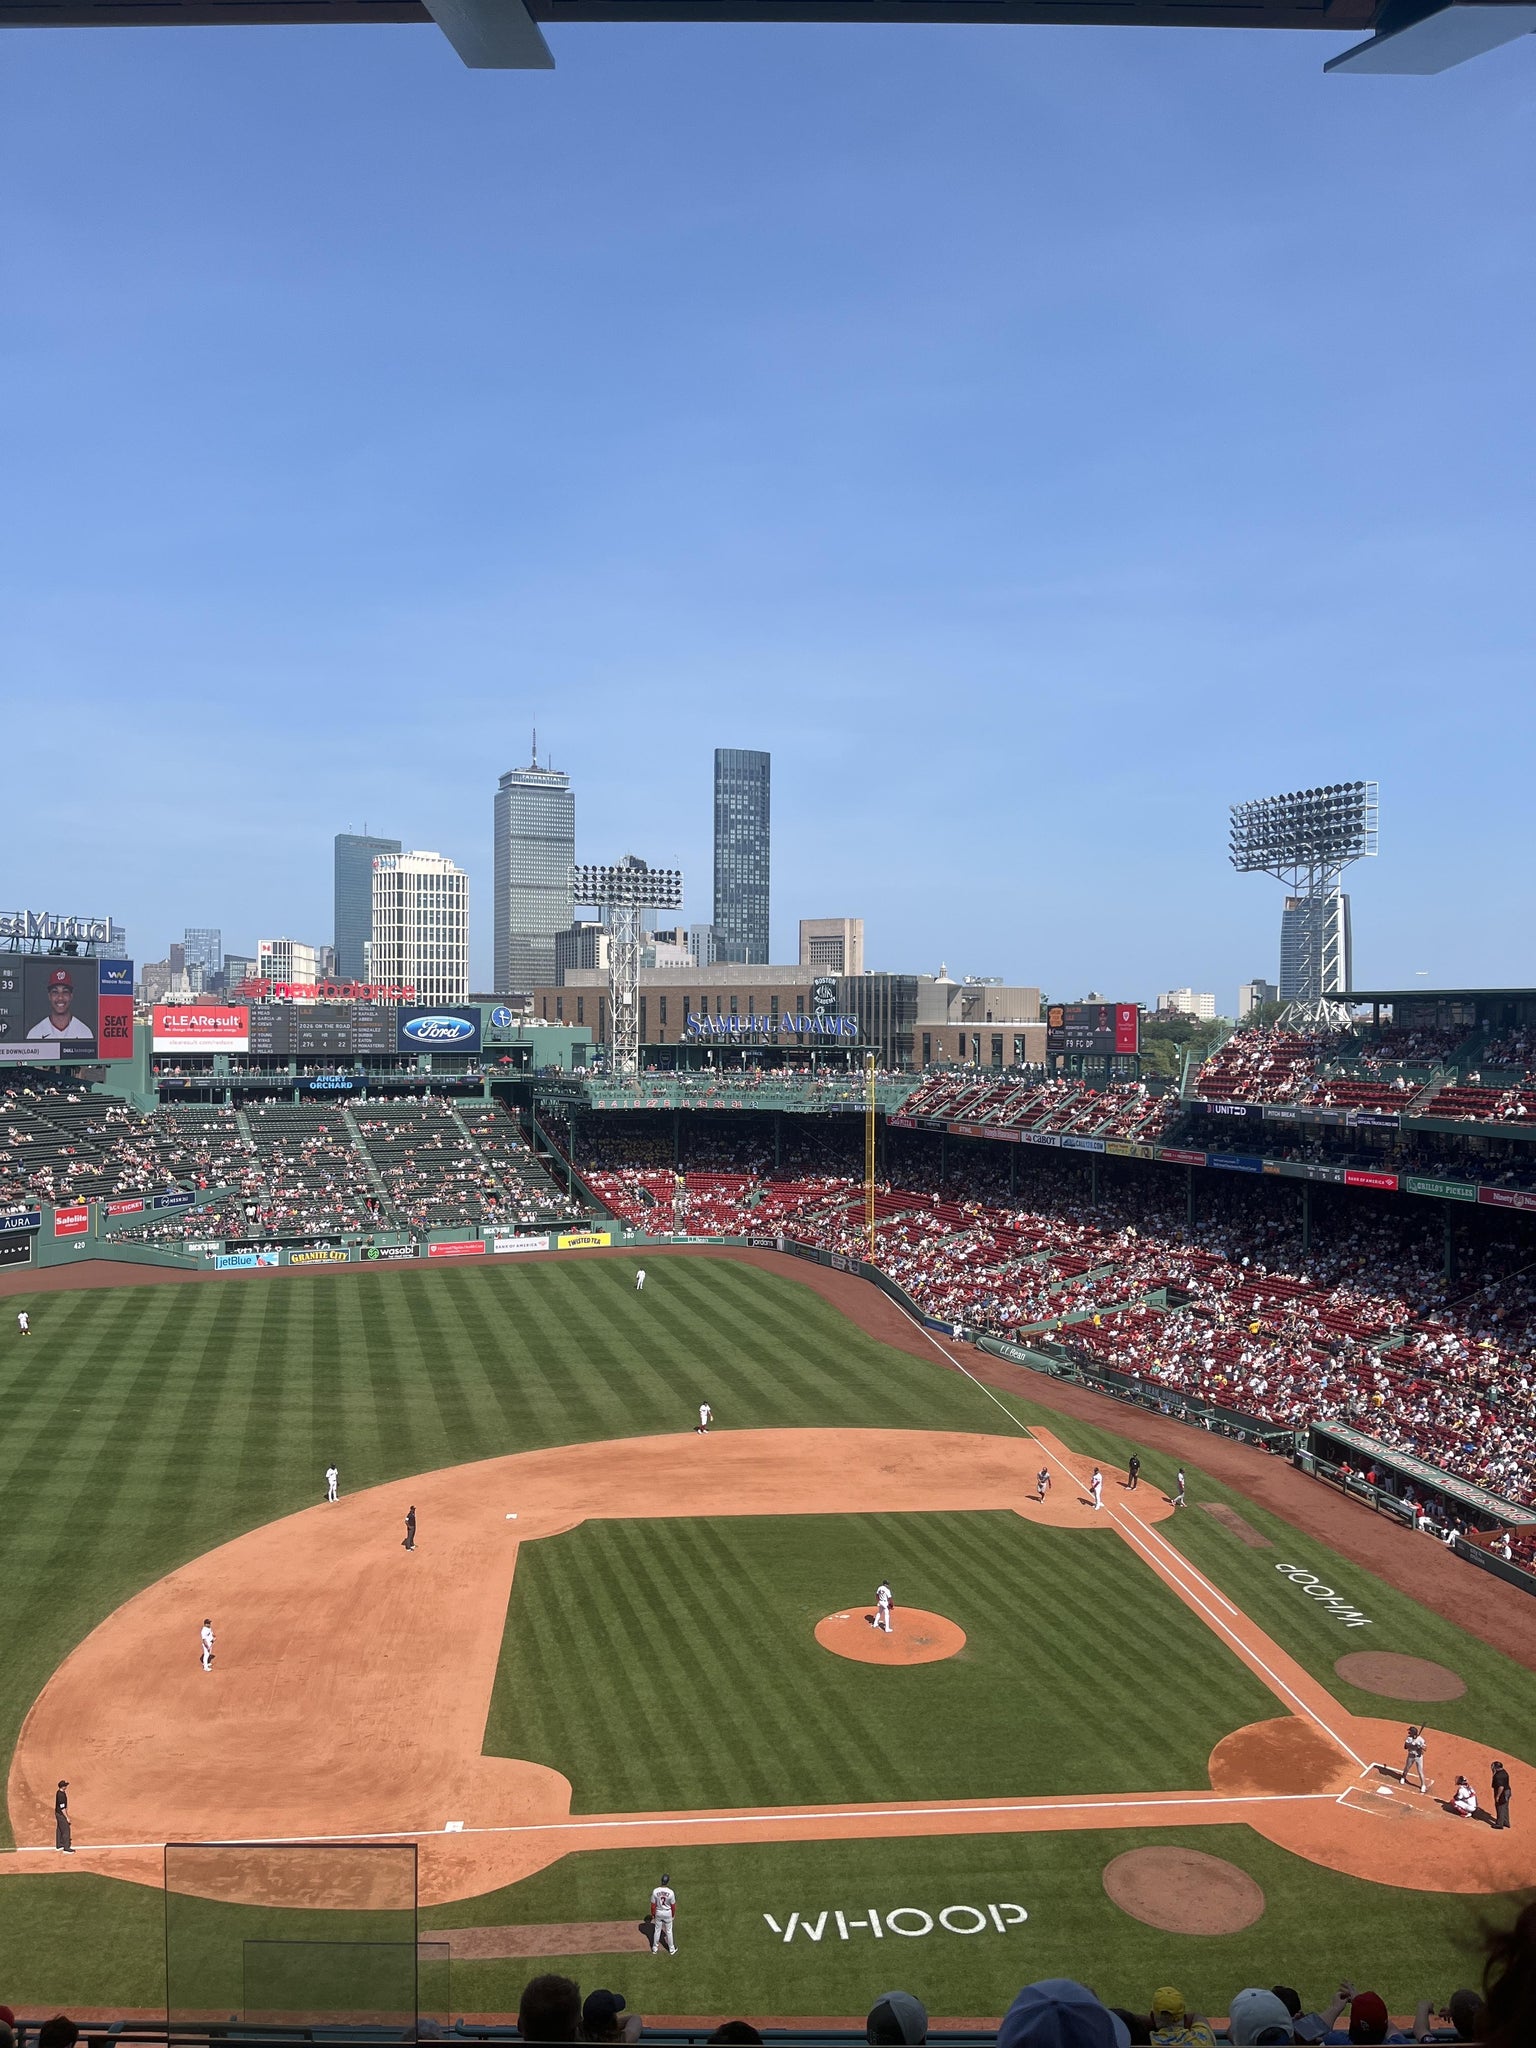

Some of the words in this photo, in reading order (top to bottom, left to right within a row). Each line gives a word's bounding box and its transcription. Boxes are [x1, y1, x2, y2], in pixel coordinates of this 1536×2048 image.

[2, 981, 14, 990] 39
[815, 977, 836, 985] BOSTON
[275, 982, 320, 999] new
[323, 979, 415, 999] balance
[104, 1016, 127, 1026] SEAT
[163, 1016, 239, 1026] CLEAResult
[686, 1012, 777, 1036] SAMUEL
[779, 1011, 857, 1036] ADAMS
[104, 1028, 128, 1038] GEEK
[418, 1020, 460, 1038] Ford
[1066, 1040, 1074, 1048] F9
[1076, 1040, 1084, 1048] FC
[1086, 1040, 1094, 1048] DP
[310, 1081, 352, 1089] ORCHARD
[1214, 1106, 1247, 1116] UNITED
[1446, 1187, 1473, 1196] PICKLES
[122, 1202, 142, 1212] TICKET
[568, 1238, 590, 1246] TWISTED
[380, 1246, 414, 1256] wasabi
[219, 1256, 252, 1267] jetBlue
[291, 1252, 328, 1263] GRANITE
[330, 1250, 348, 1260] CITY
[1274, 1564, 1374, 1628] WHOOP
[763, 1903, 1028, 1943] WHOOP
